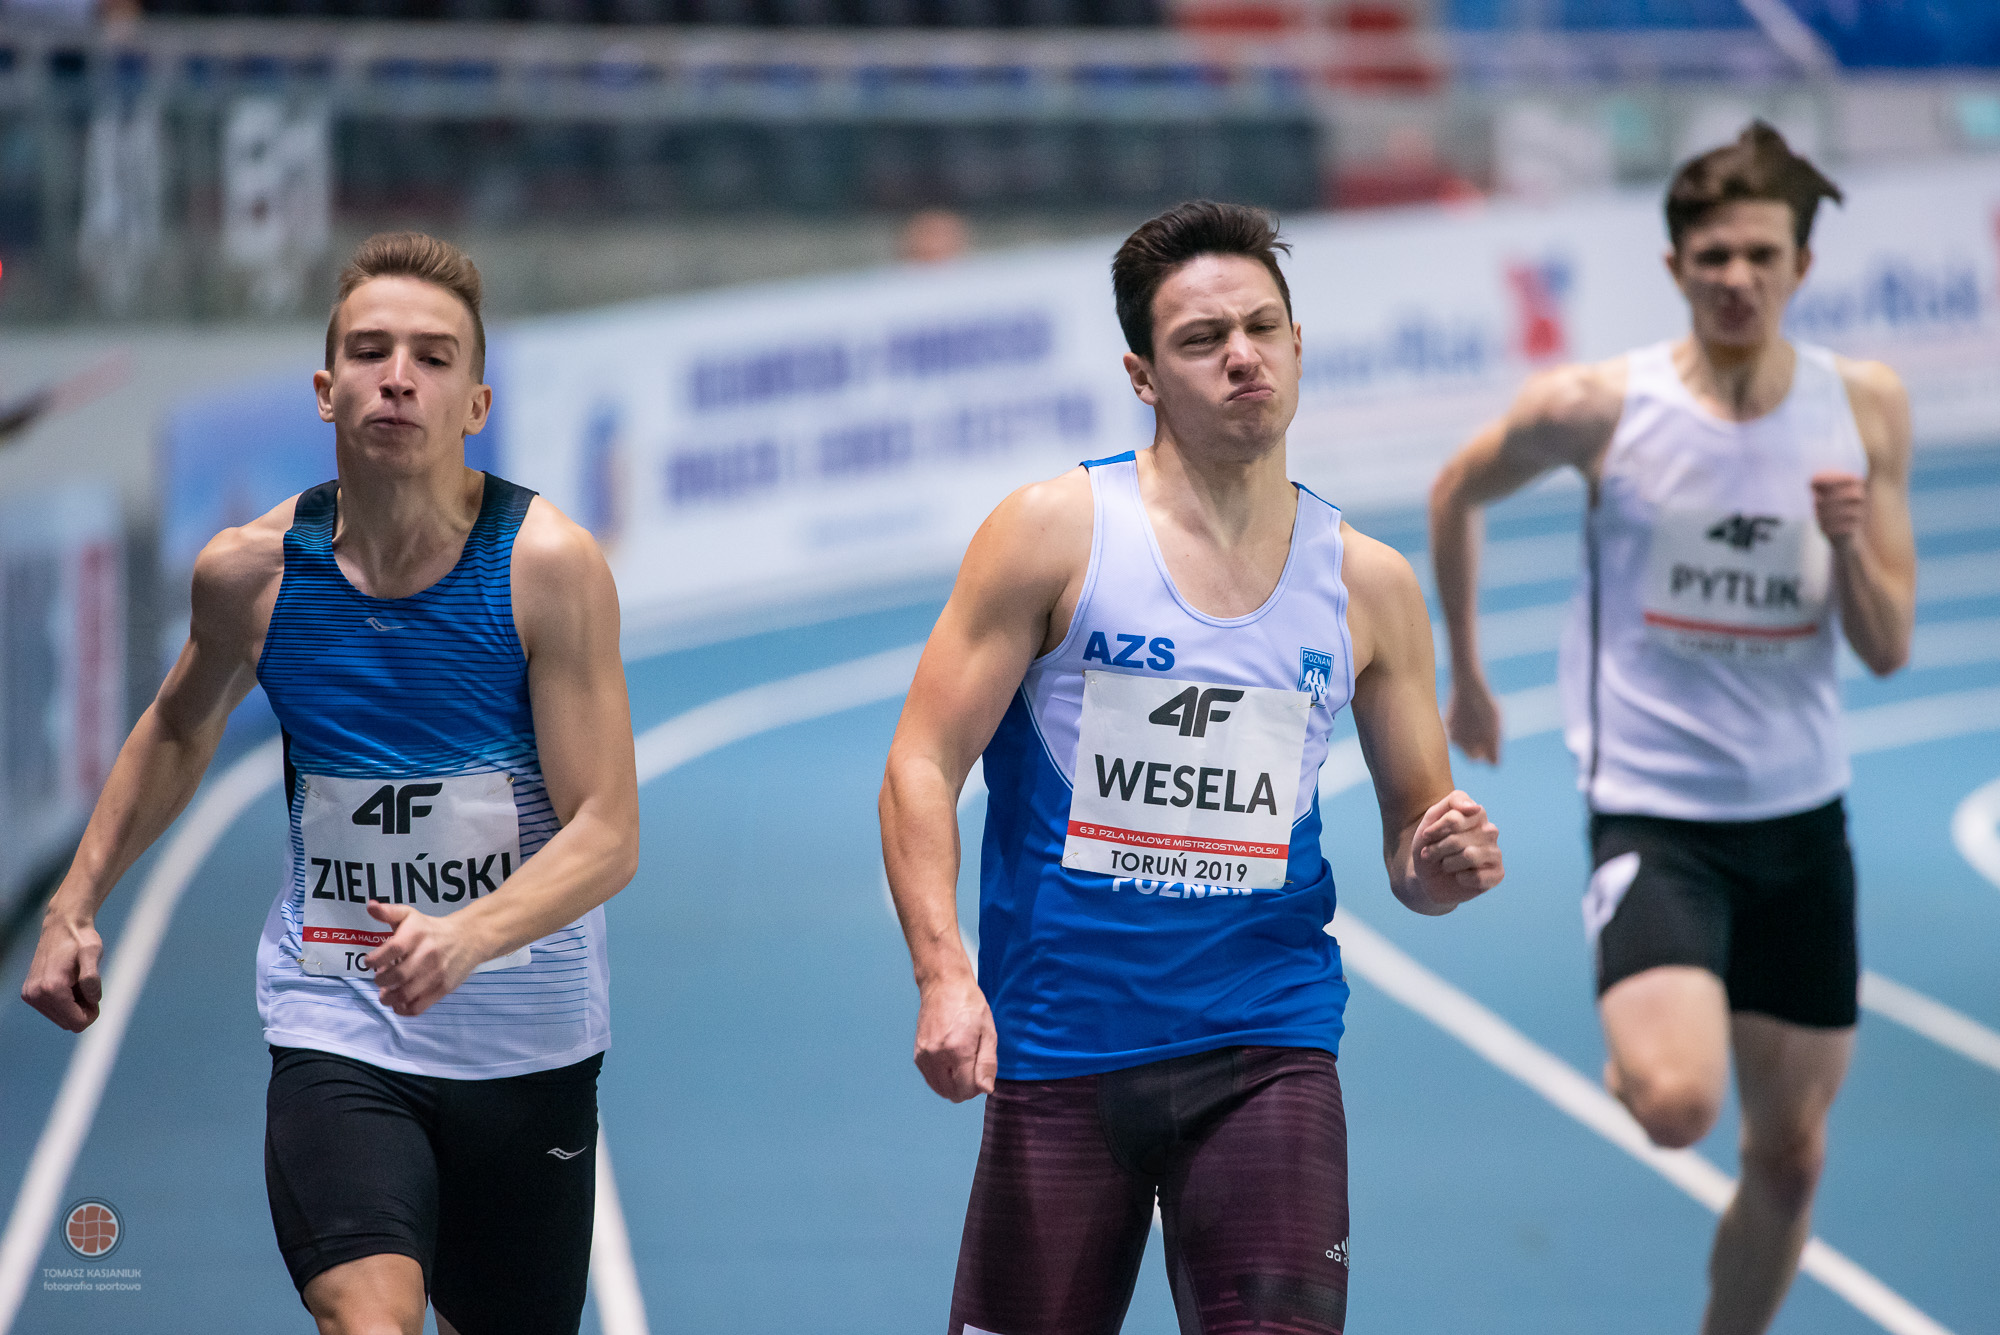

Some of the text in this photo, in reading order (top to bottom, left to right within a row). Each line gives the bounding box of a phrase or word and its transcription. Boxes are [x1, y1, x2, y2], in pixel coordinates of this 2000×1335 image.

[1083, 631, 1176, 671] AZS
[1149, 686, 1245, 738] 4F
[1095, 753, 1277, 815] WESELA
[352, 782, 443, 834] 4F
[1079, 826, 1279, 856] 63. PZLA HALOWE MISTRZOSTWA POLSKI
[311, 852, 512, 904] ZIELIŃSKI
[1111, 850, 1248, 883] TORUŃ 2019
[313, 931, 393, 943] 63. PZLA HALOW
